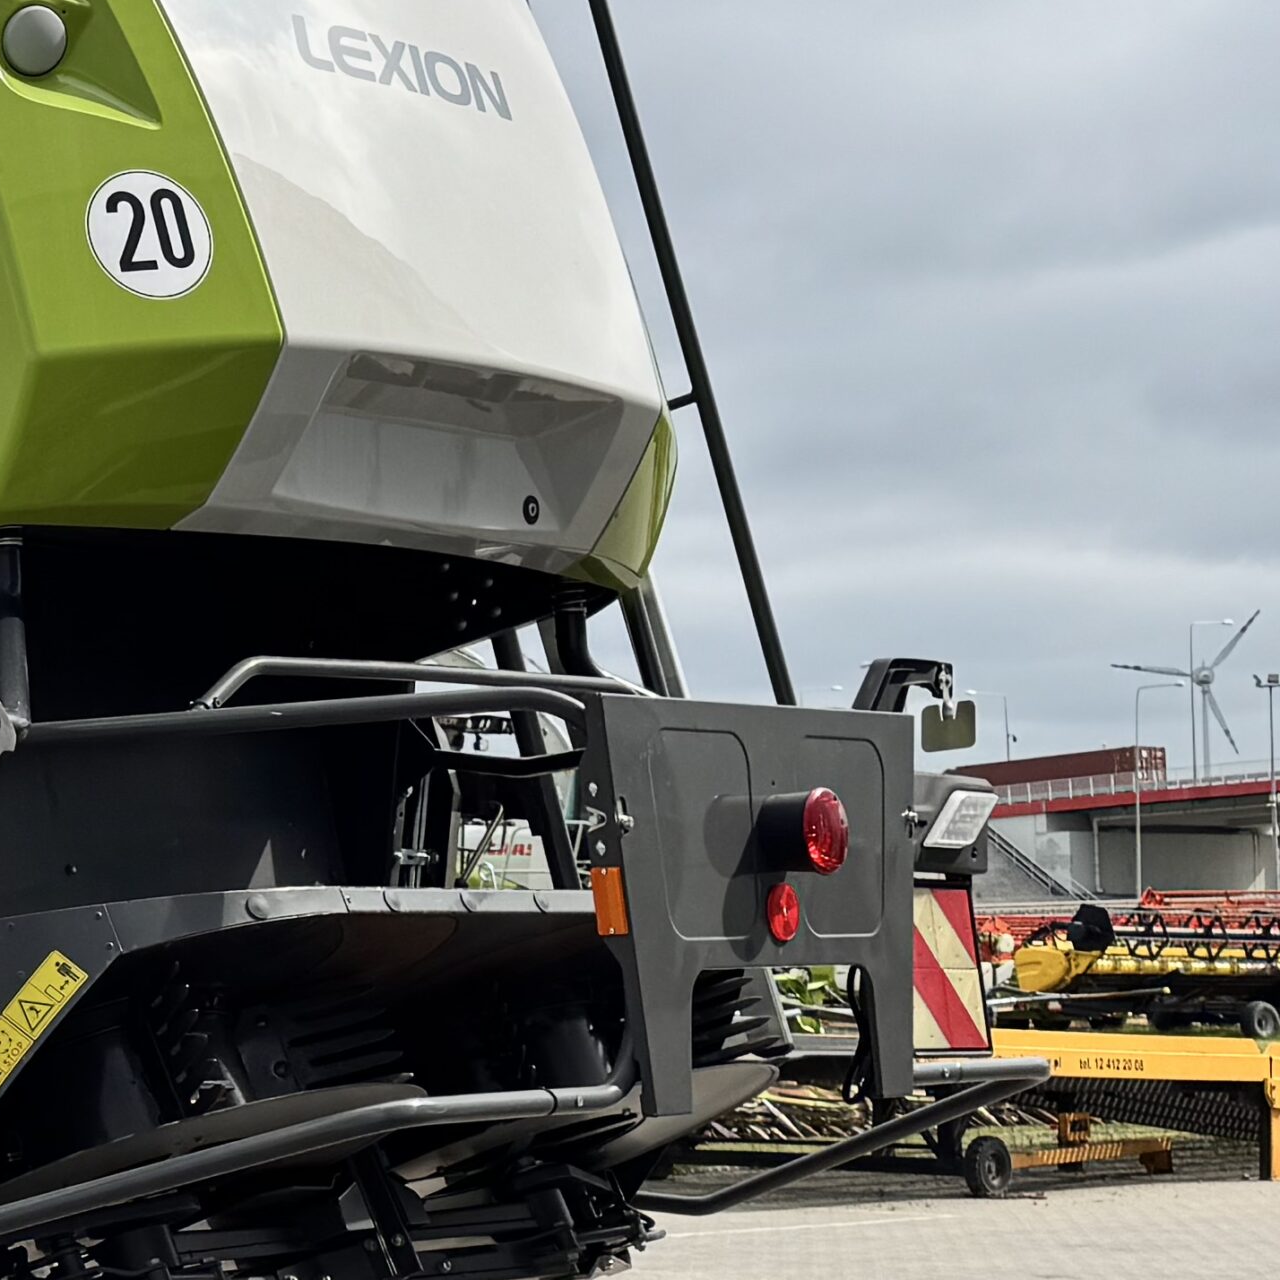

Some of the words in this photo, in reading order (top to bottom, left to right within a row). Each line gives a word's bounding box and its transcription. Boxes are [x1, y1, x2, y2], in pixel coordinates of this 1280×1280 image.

[292, 14, 512, 121] LEXION
[105, 188, 195, 273] 20
[3, 1041, 23, 1066] STOP
